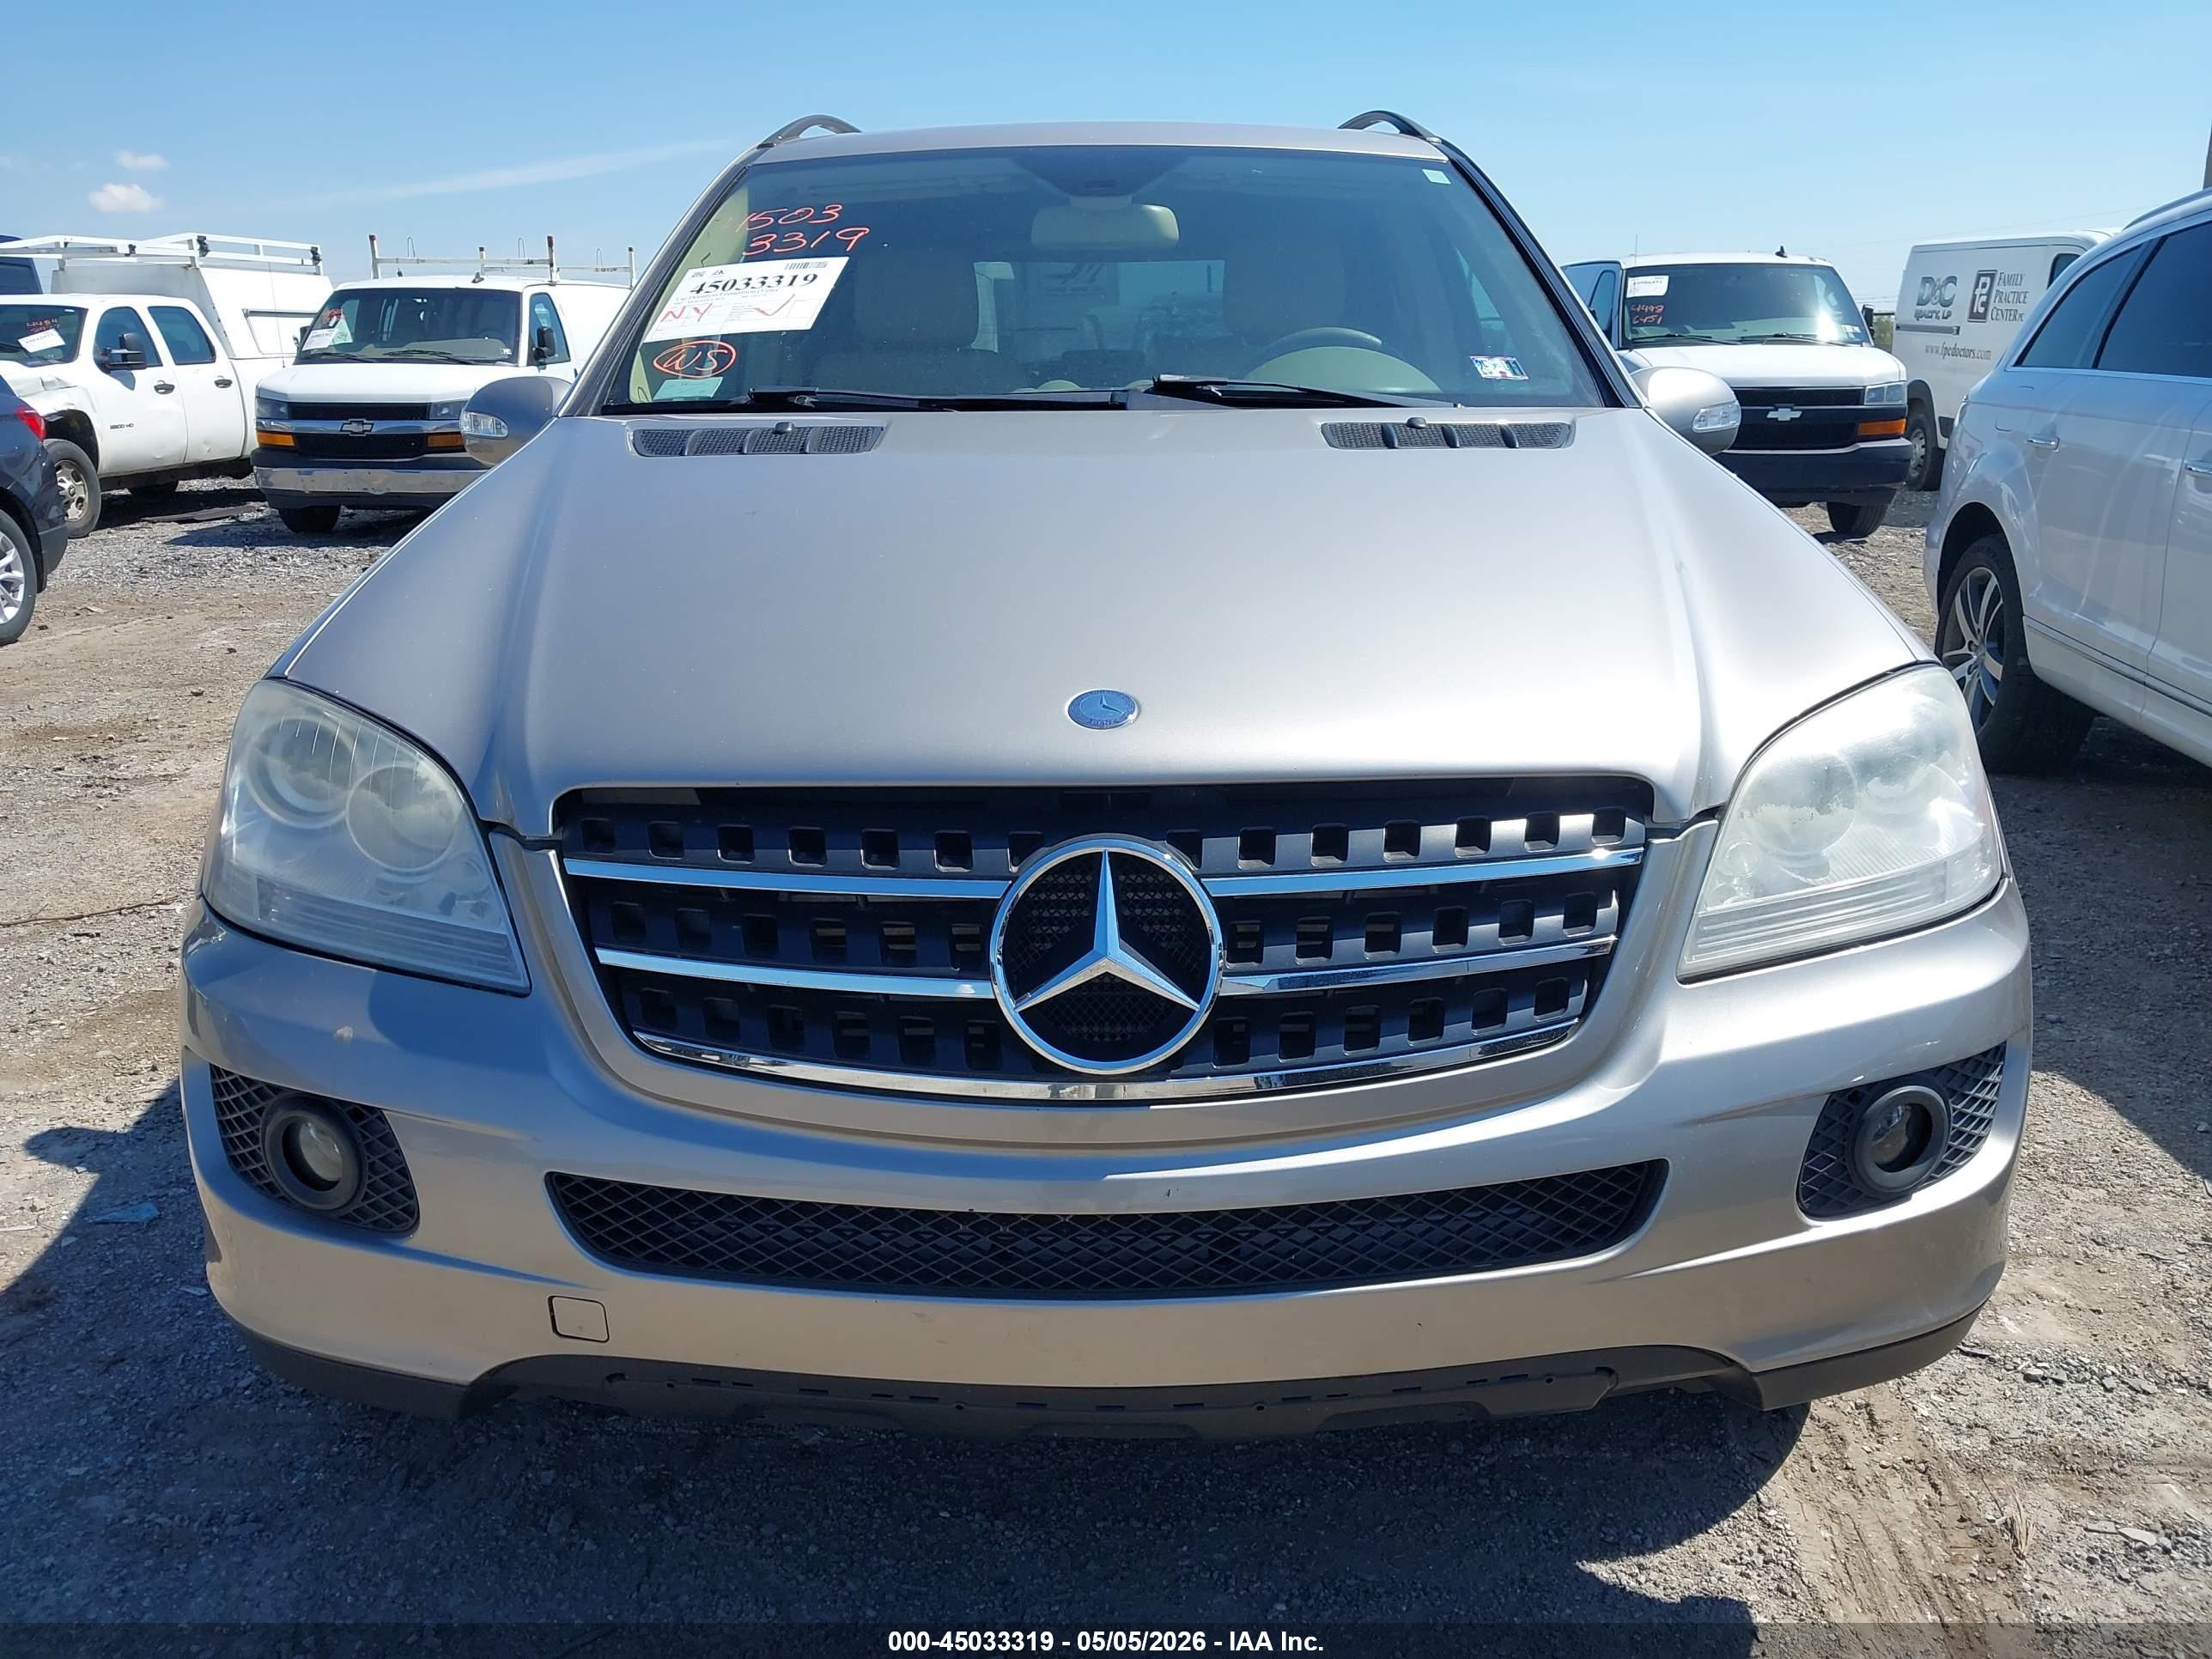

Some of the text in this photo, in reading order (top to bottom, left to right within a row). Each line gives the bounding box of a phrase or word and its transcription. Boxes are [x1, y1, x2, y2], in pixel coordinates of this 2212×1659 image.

[742, 228, 871, 256] 3319
[690, 273, 818, 295] 45033319
[1997, 272, 2026, 287] FAMILY
[1994, 289, 2029, 304] PRACTICE
[1990, 307, 2018, 322] CENTER
